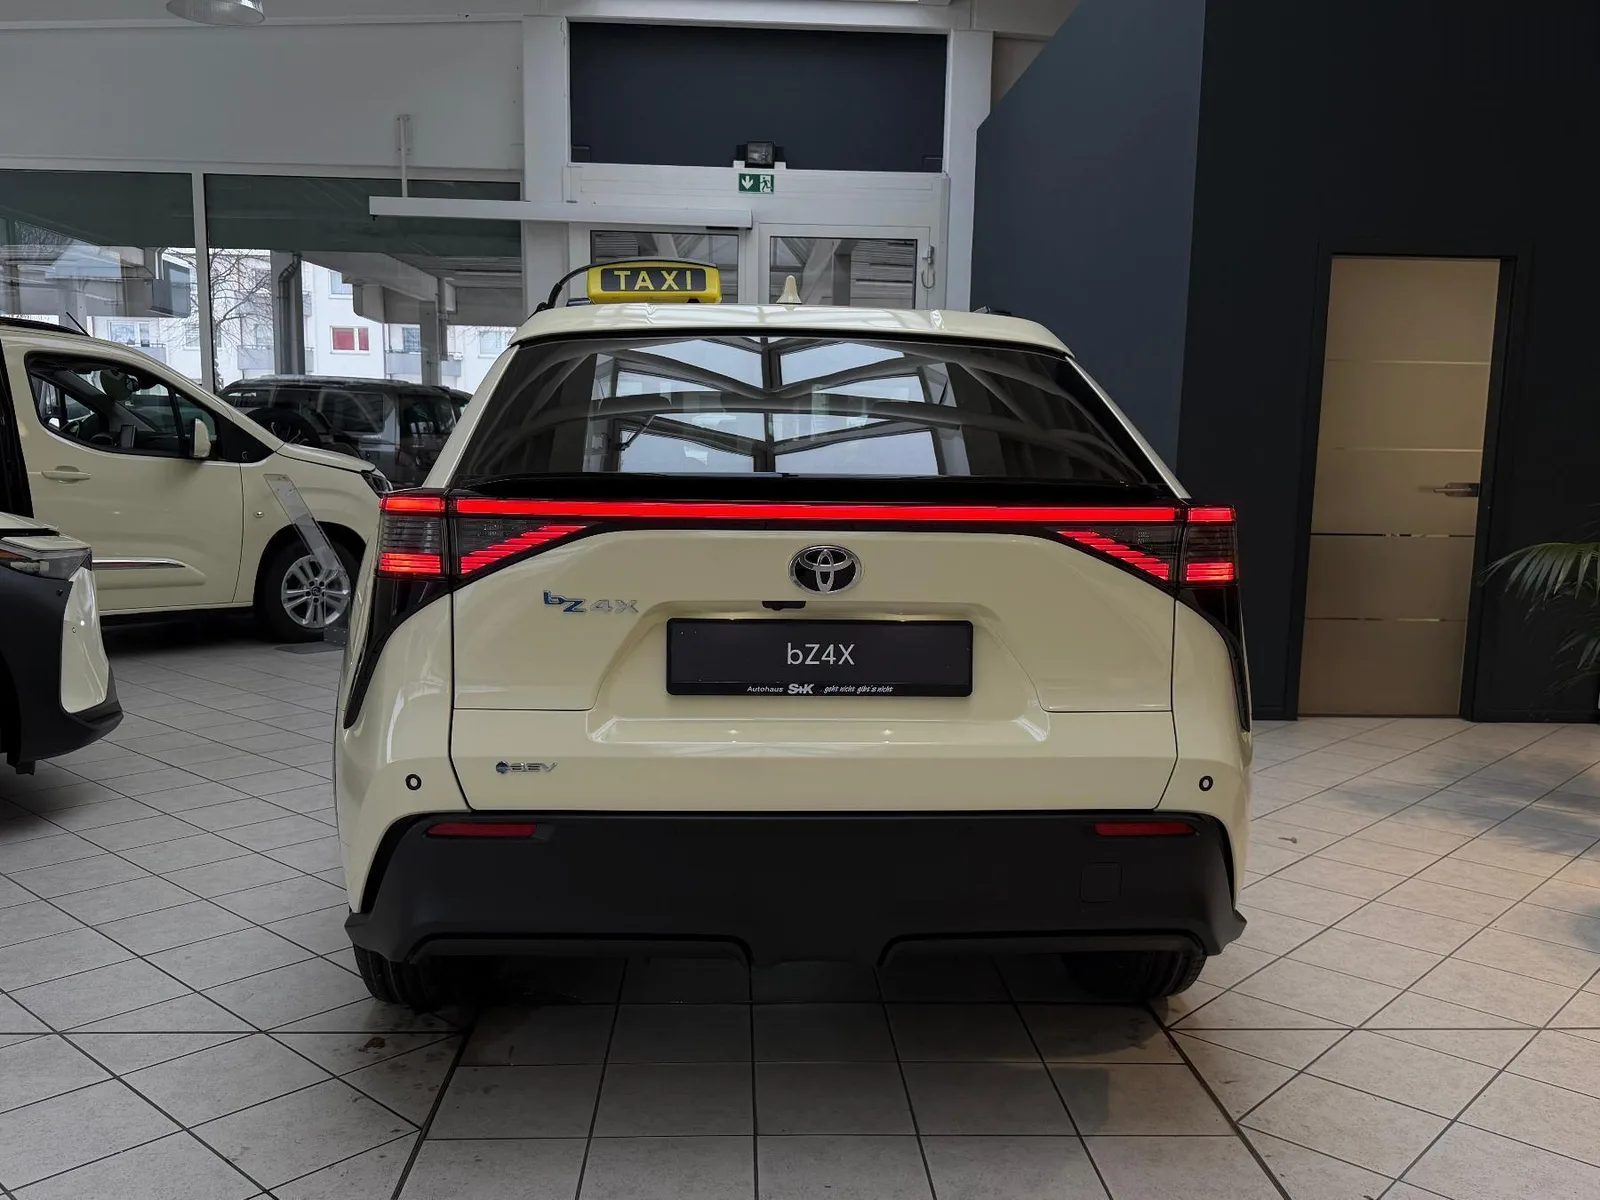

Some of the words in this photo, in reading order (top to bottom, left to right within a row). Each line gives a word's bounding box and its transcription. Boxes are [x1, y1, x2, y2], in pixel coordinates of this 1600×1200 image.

[613, 270, 692, 291] TAXI
[786, 642, 856, 666] bZ4X
[746, 685, 784, 693] Autohaus
[839, 685, 856, 693] nicht
